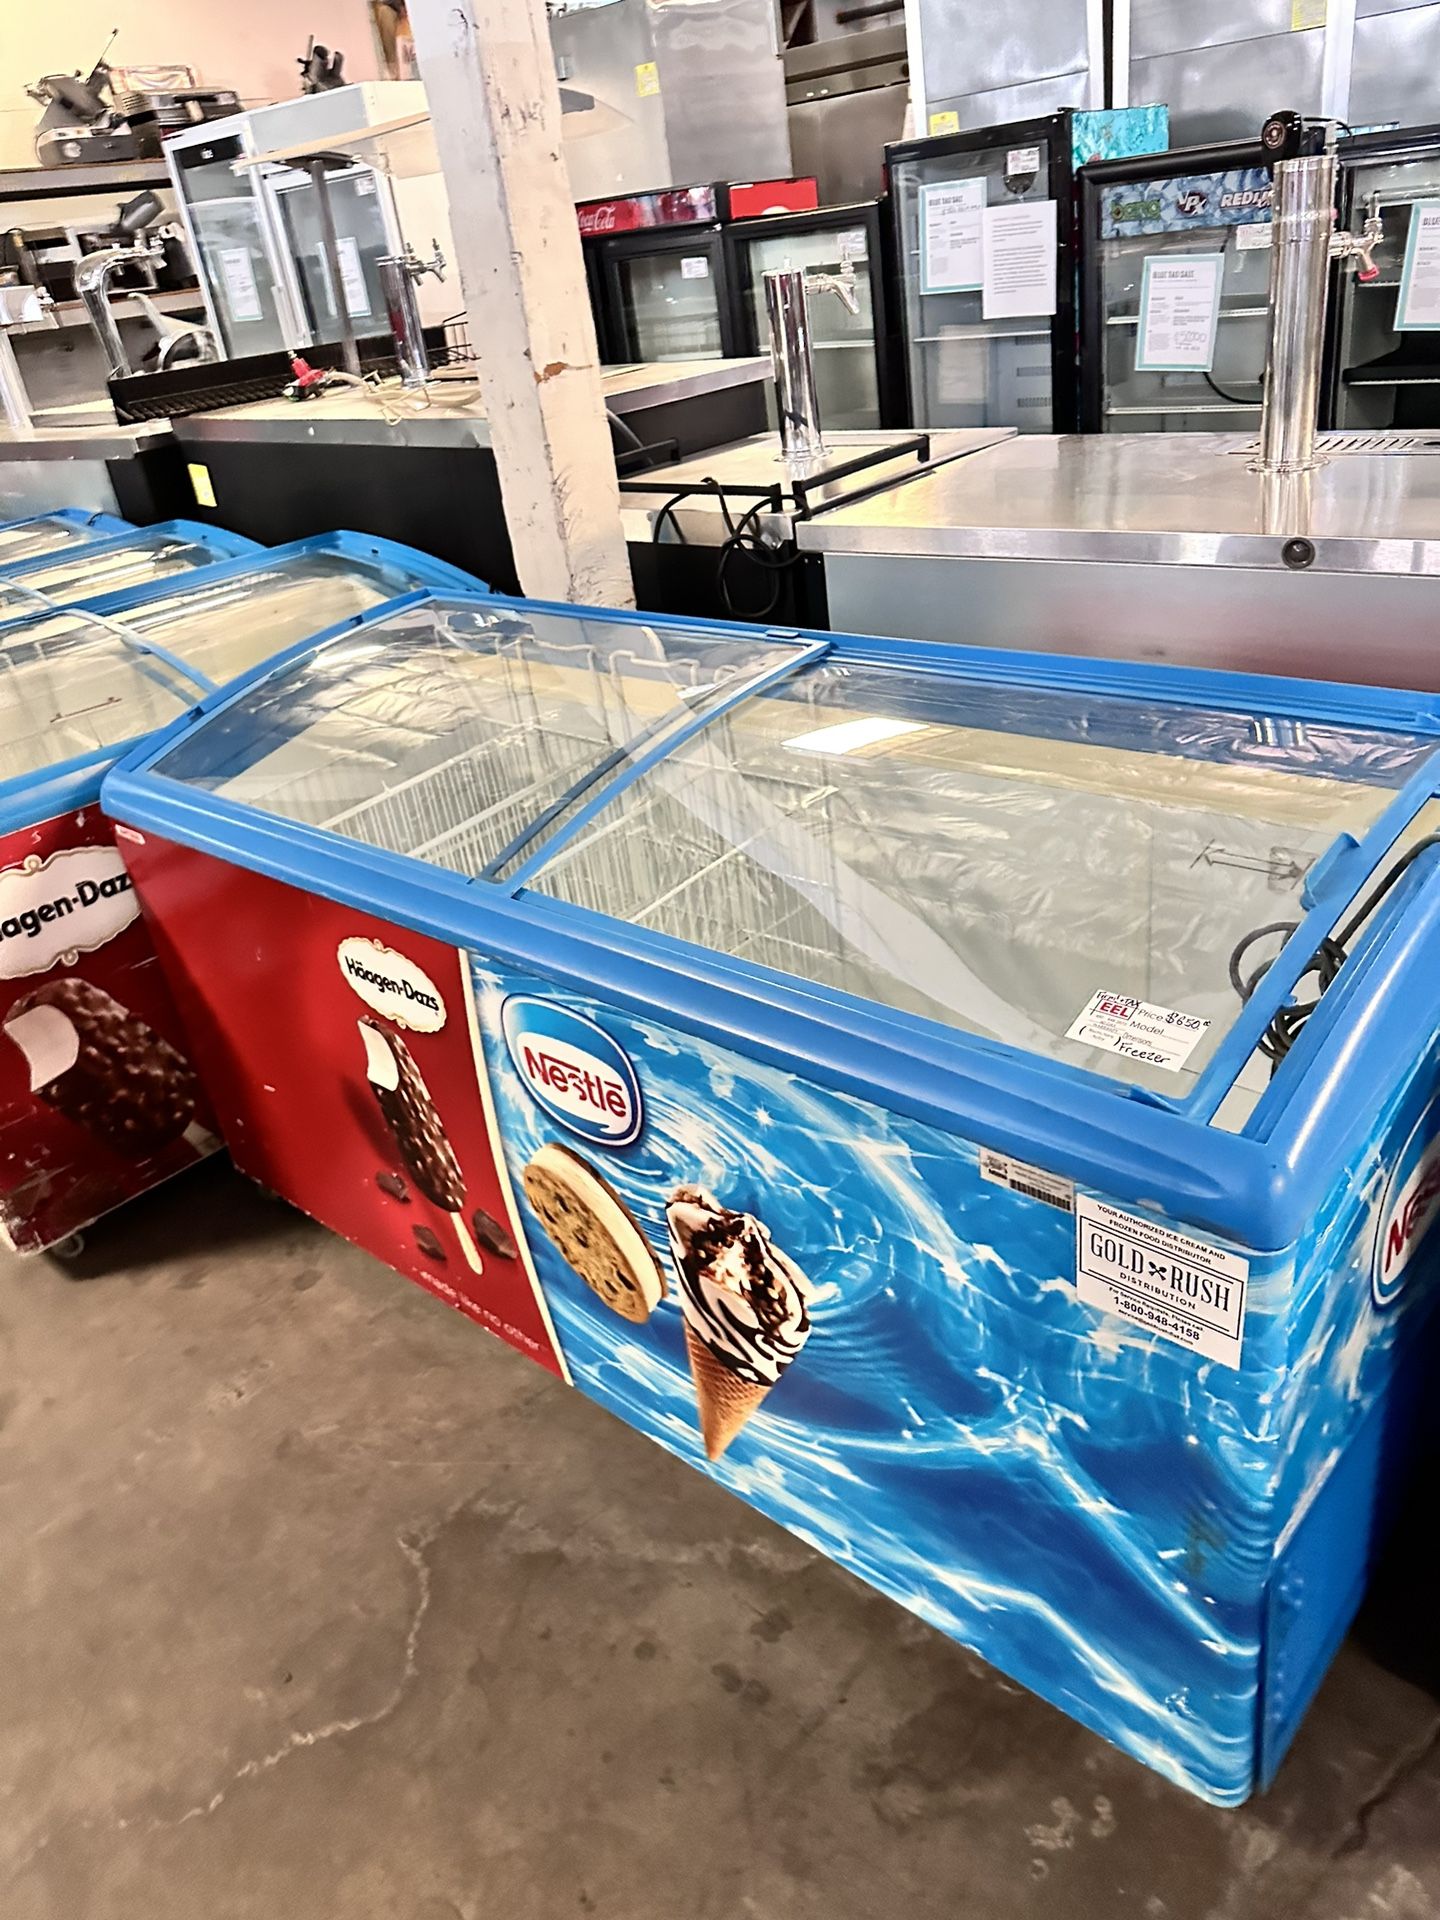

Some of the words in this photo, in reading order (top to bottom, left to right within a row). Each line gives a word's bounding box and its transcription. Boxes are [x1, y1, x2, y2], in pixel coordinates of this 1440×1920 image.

[0, 872, 134, 940] agen-Daz
[345, 956, 439, 1011] Häagen-Dazs
[1100, 1002, 1129, 1018] EEL
[1130, 1020, 1164, 1036] Model
[1138, 1008, 1164, 1022] Price
[1119, 1042, 1170, 1063] Freezer
[1097, 1203, 1117, 1218] YOUR
[1118, 1212, 1164, 1236] AUTHORIZED
[1166, 1231, 1178, 1242] ICE
[1179, 1236, 1207, 1253] CREAM
[1208, 1248, 1225, 1261] AND
[1108, 1217, 1138, 1235] FROZEN
[1138, 1230, 1160, 1245] FOOD
[1161, 1239, 1212, 1266] DISTRIBUTOR
[1091, 1232, 1143, 1275] GOLD
[1170, 1264, 1230, 1312] RUSH
[1119, 1272, 1196, 1310] DISTRIBUTION
[1113, 1294, 1200, 1341] 1-800-948-4158
